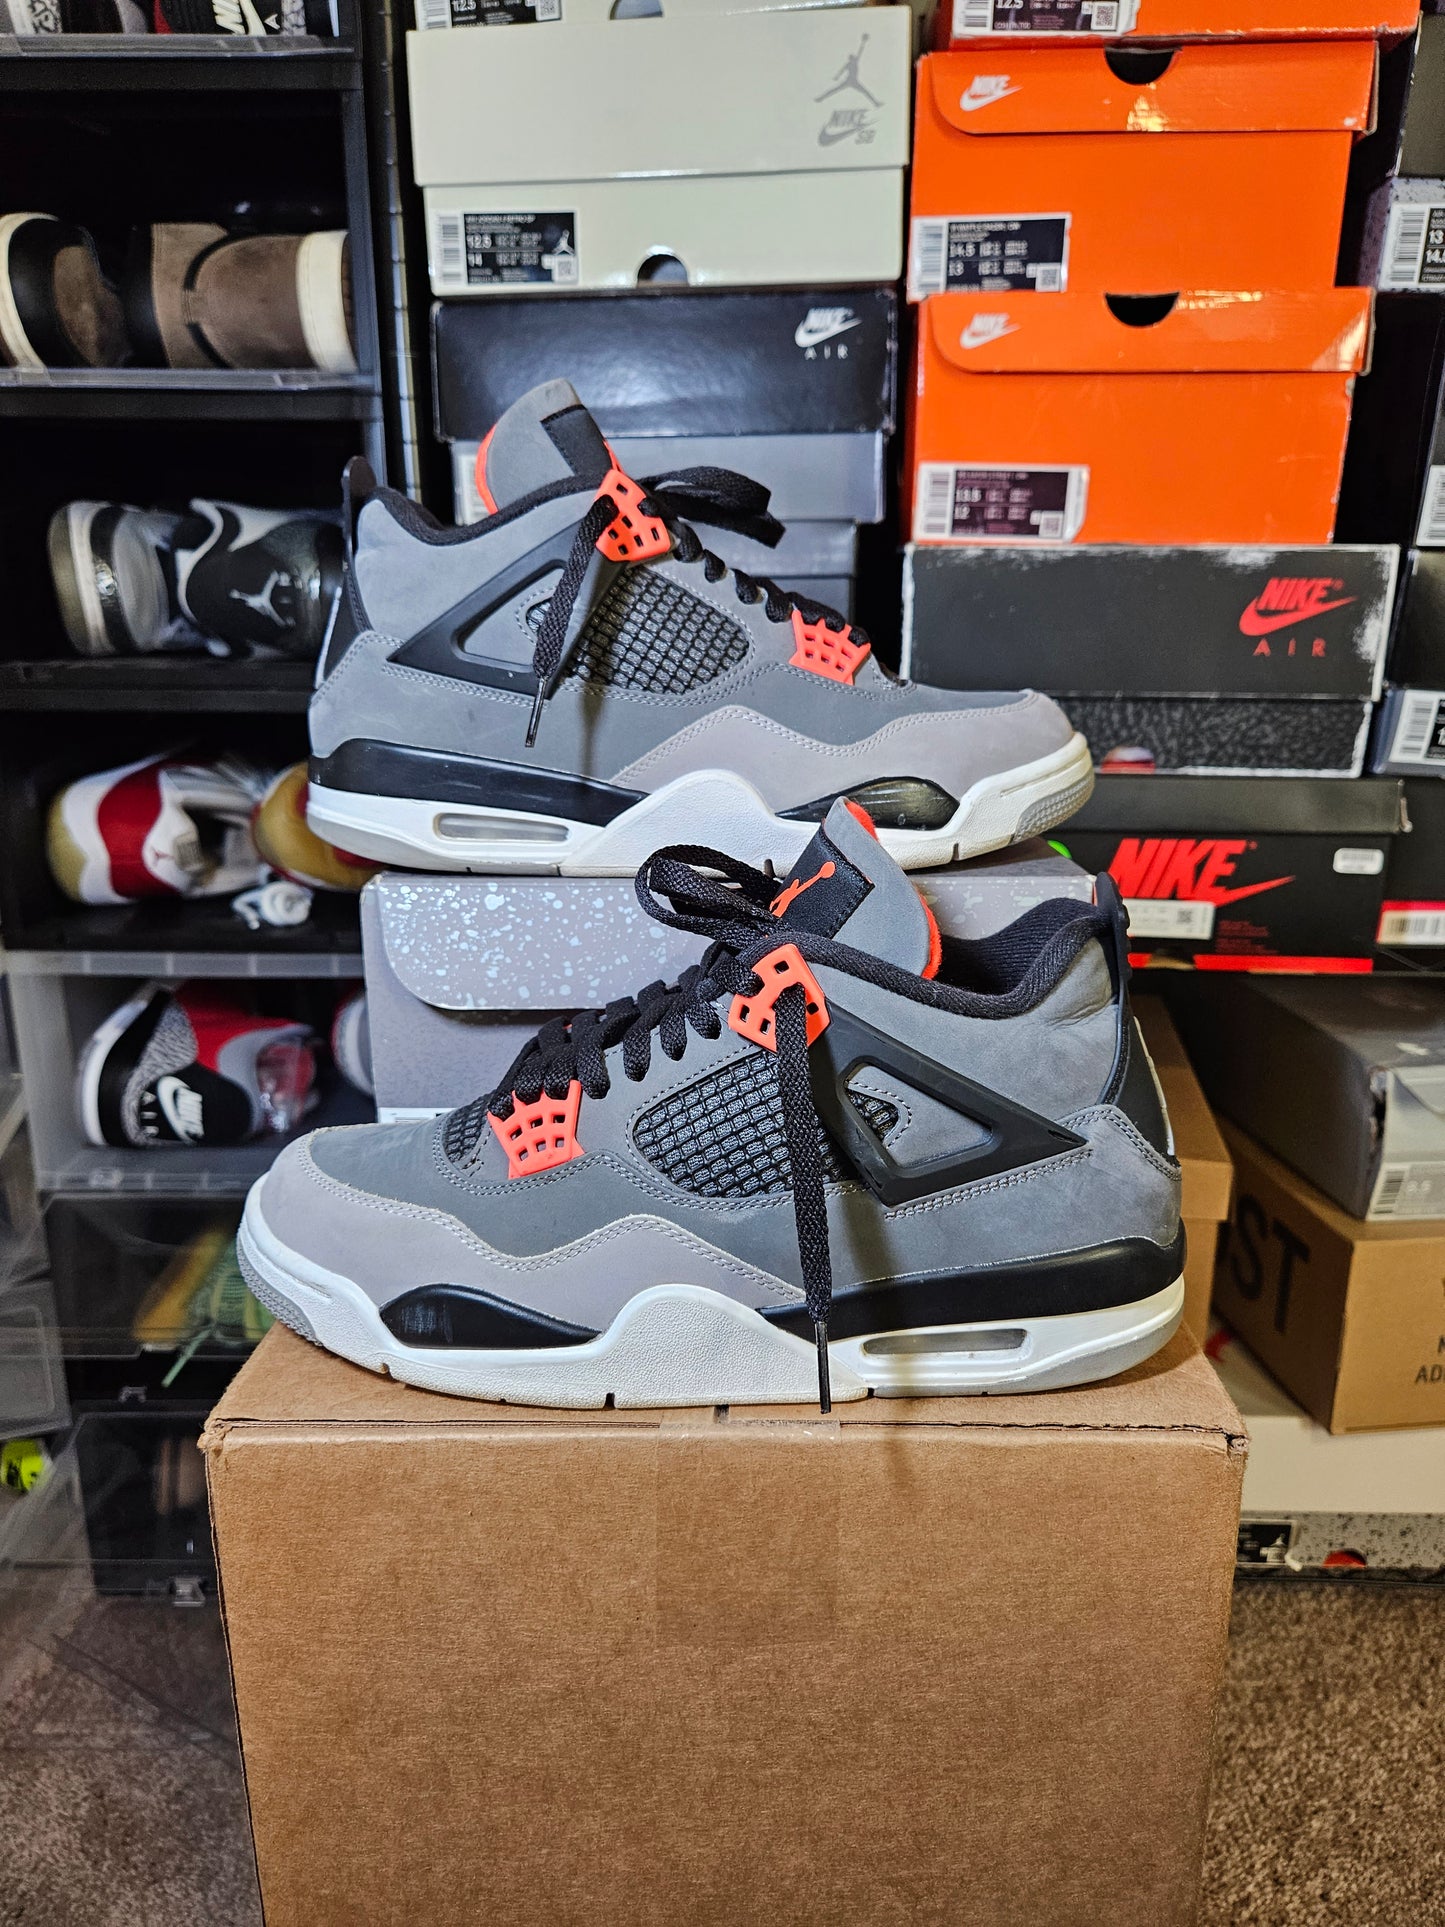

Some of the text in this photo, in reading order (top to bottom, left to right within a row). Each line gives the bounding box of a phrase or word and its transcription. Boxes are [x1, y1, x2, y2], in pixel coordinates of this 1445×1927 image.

[971, 75, 1012, 97] NIKE
[829, 109, 870, 128] NIKE
[466, 233, 492, 249] 12.5
[803, 307, 854, 331] NIKE
[970, 311, 1011, 333] NIKE
[804, 344, 849, 360] AIR
[1256, 577, 1334, 611] NIKE
[1252, 637, 1326, 657] AIR
[1107, 838, 1247, 902] NIKE
[1414, 1364, 1445, 1384] AD
